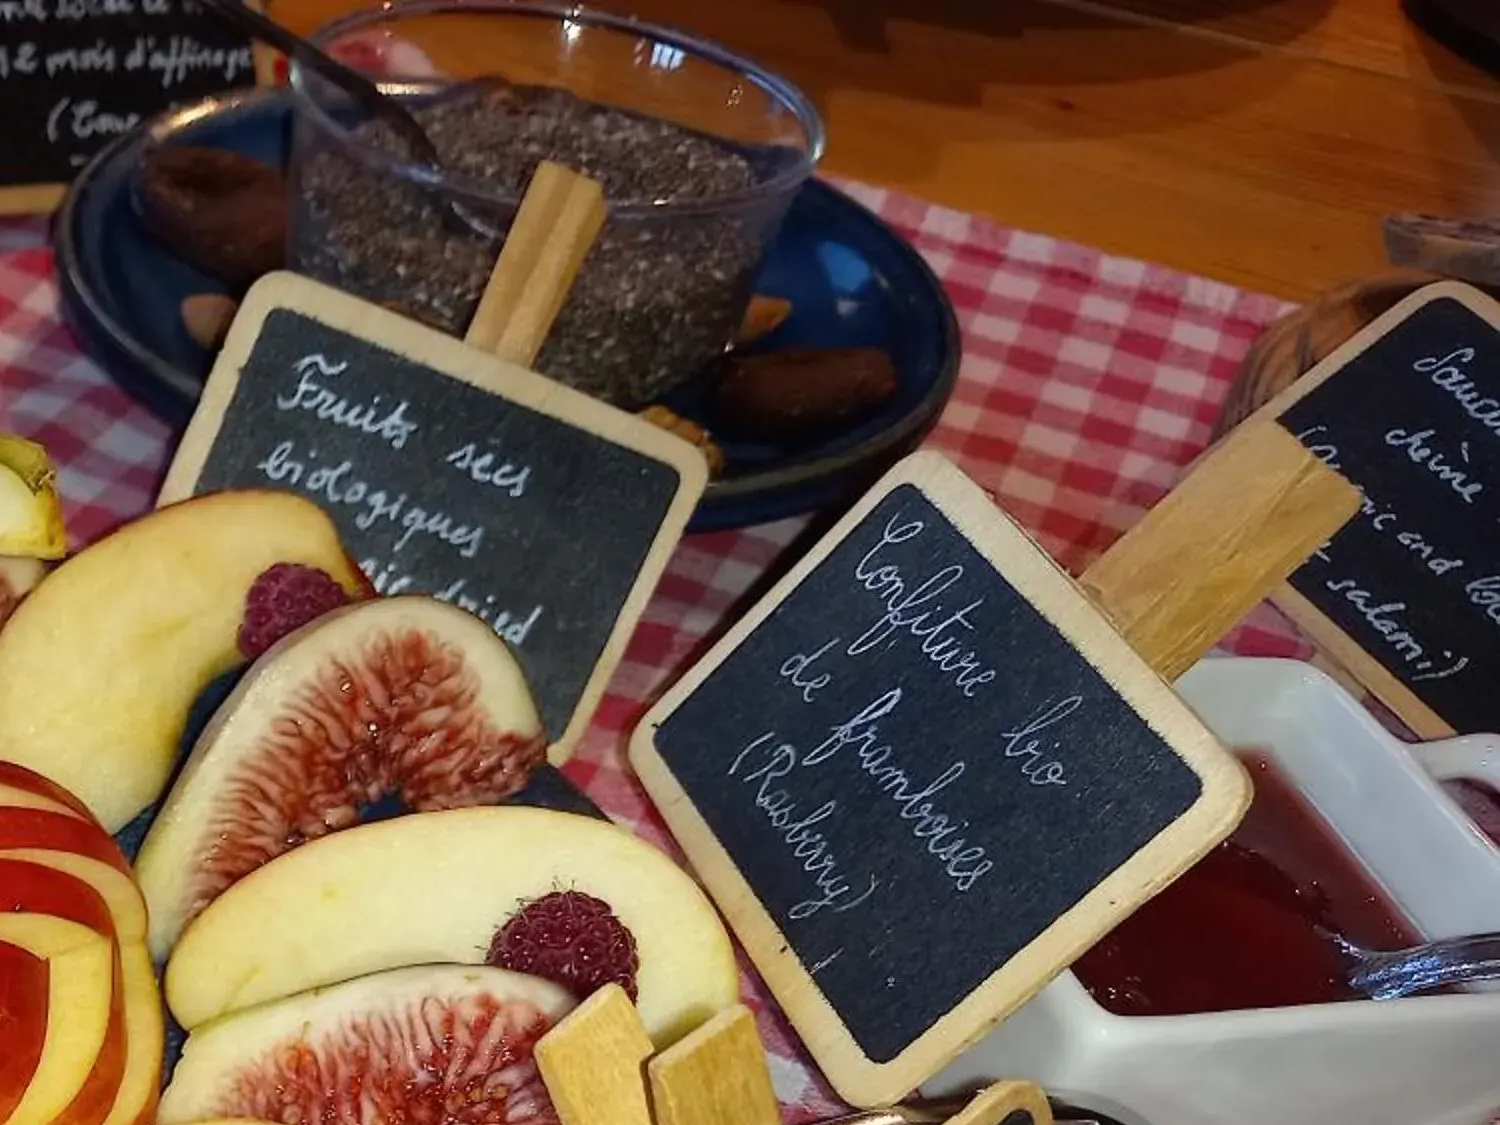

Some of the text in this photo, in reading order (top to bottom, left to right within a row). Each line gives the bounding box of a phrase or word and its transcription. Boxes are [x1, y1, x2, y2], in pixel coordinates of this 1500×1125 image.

[45, 36, 116, 79] mois
[277, 354, 532, 496] Fruits secs
[258, 441, 485, 558] biologiques
[1397, 532, 1463, 575] and
[847, 512, 1082, 785] Confiture bio
[779, 638, 993, 892] de framboises
